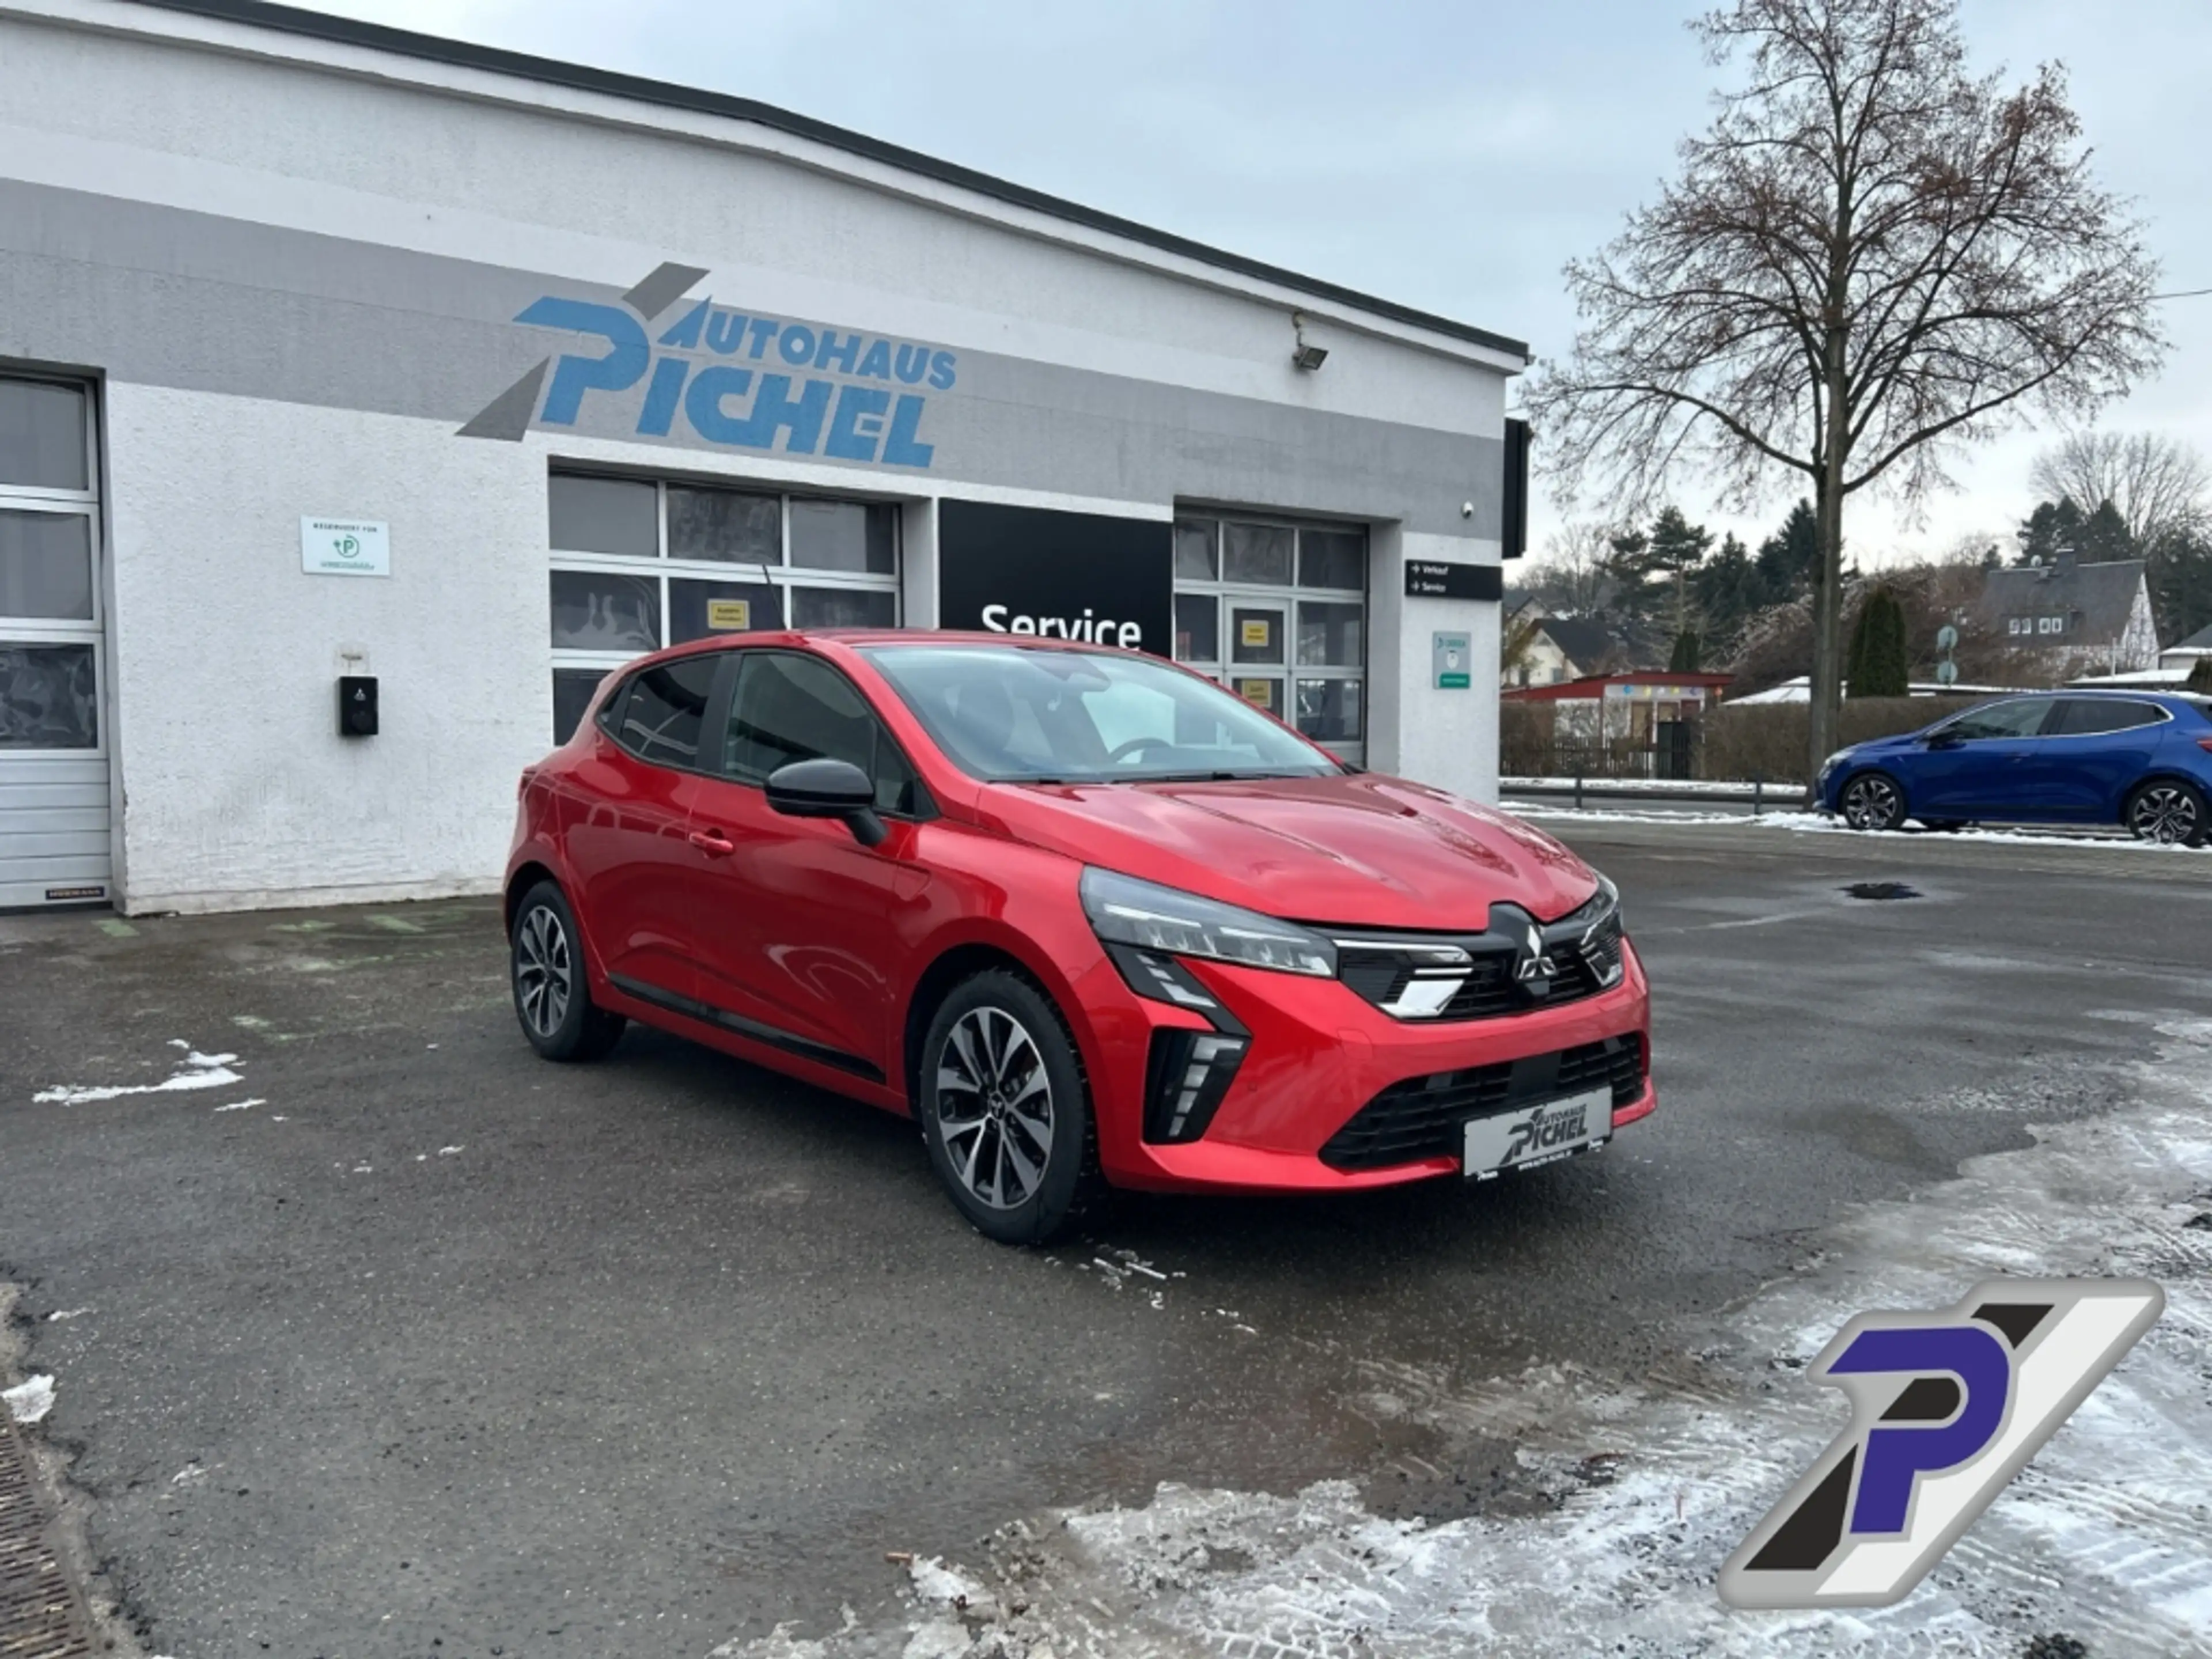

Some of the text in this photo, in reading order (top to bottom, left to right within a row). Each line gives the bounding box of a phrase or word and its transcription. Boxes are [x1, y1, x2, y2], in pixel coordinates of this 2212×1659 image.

[656, 296, 956, 390] AUTOHAUS
[512, 296, 934, 467] PICHEL
[1422, 565, 1449, 575] Verkauf
[1422, 582, 1446, 592] Service
[982, 604, 1142, 651] Service
[1508, 1115, 1588, 1156] PICHEL
[1536, 1104, 1587, 1126] AUTOHAUS
